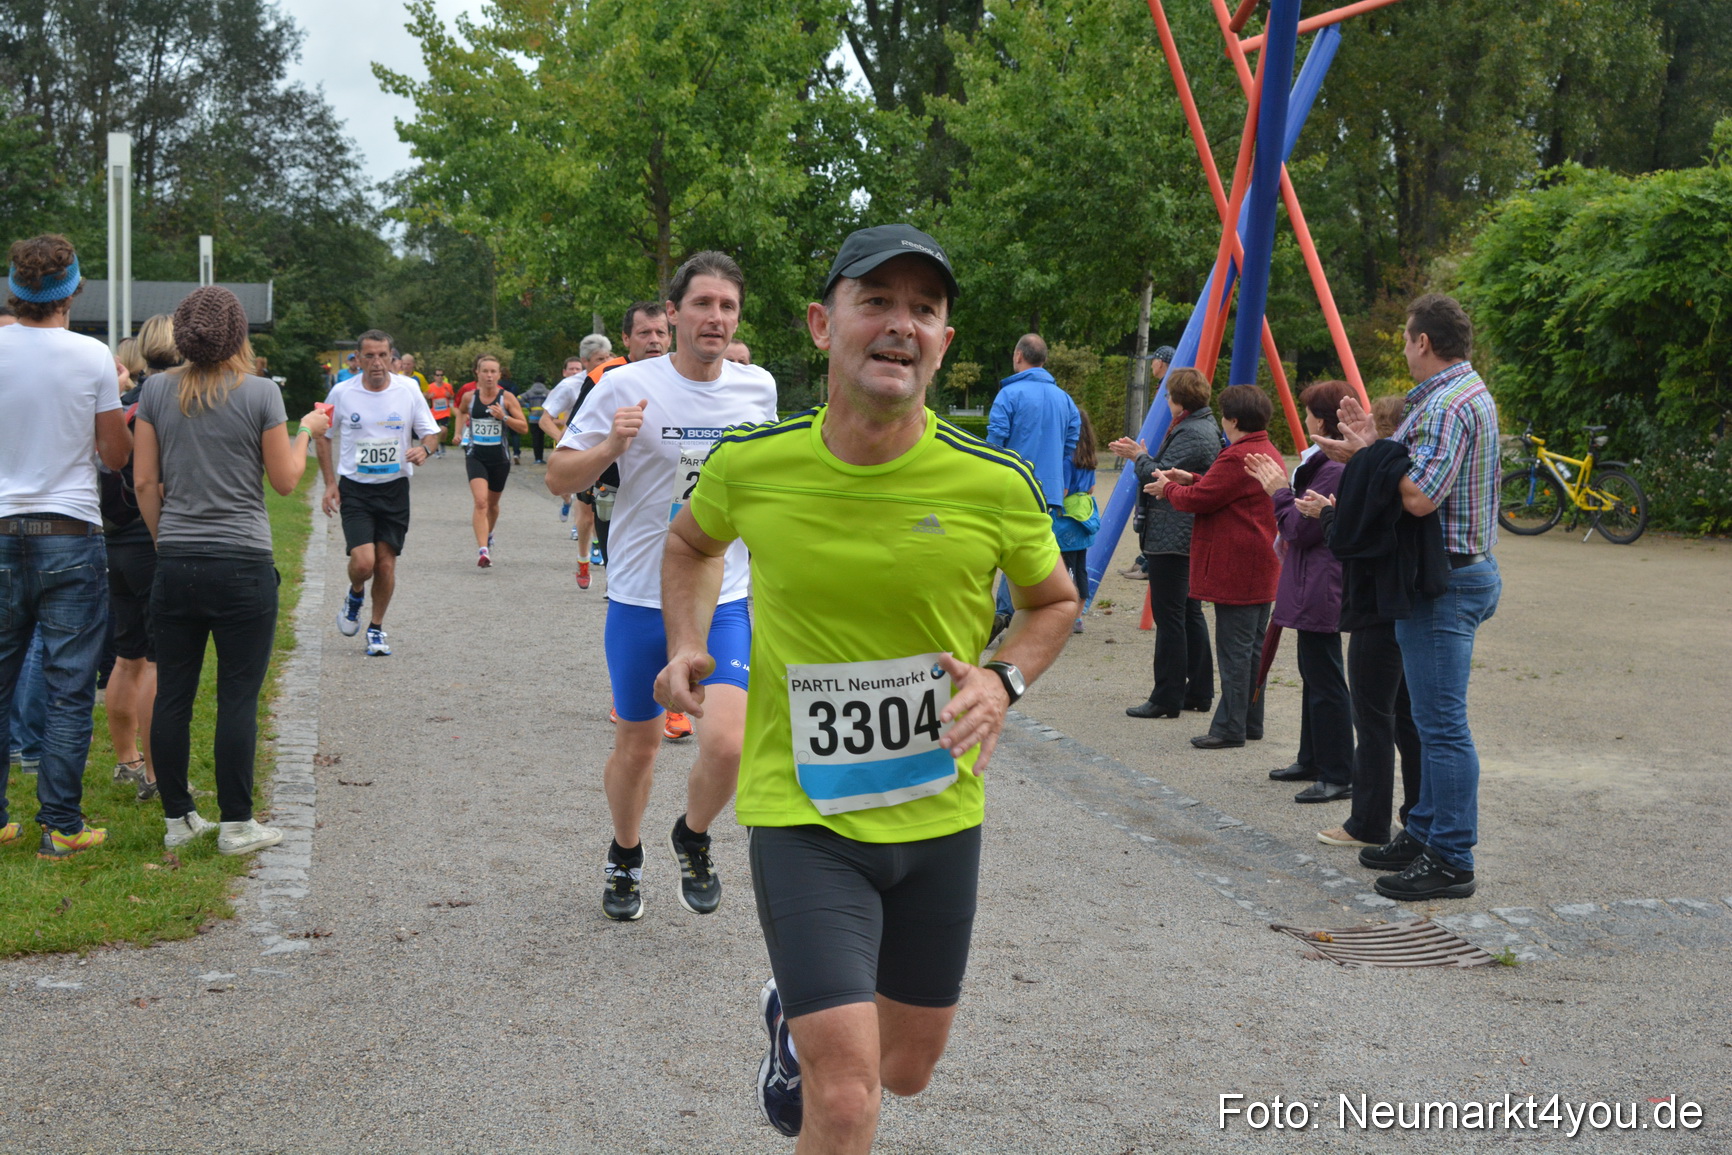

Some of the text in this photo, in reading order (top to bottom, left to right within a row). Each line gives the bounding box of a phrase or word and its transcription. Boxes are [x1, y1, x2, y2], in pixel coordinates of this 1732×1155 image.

[901, 240, 935, 256] Reebok
[475, 423, 499, 435] 2375
[360, 447, 396, 463] 2052
[911, 526, 946, 535] adidas
[791, 670, 926, 692] PARTL Neumarkt
[808, 688, 942, 757] 3304
